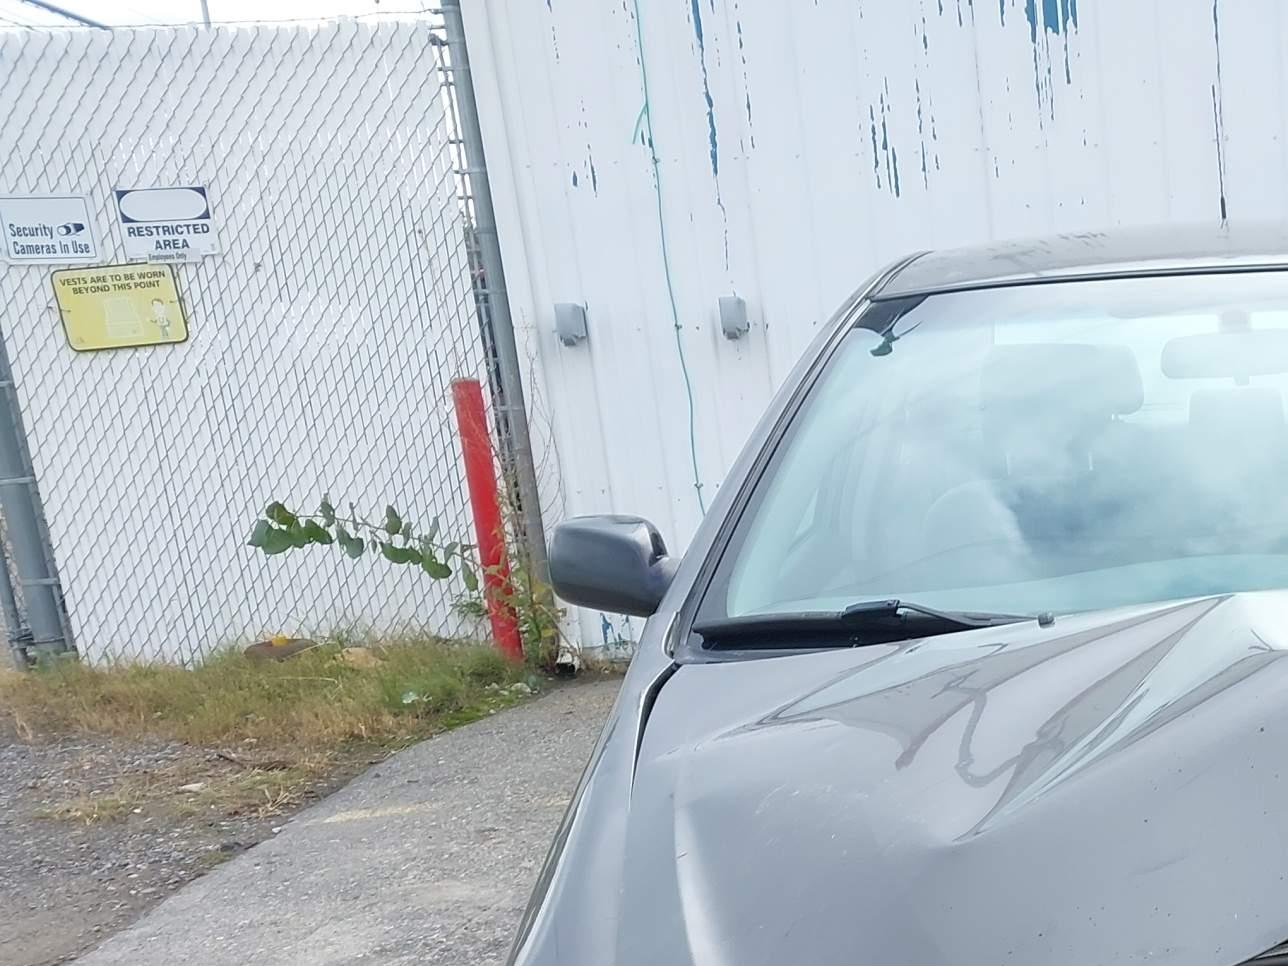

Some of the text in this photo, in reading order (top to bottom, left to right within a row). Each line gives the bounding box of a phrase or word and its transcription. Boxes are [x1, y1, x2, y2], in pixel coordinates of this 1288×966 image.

[9, 223, 53, 239] Security
[127, 223, 210, 237] RESTRICTED
[13, 240, 90, 255] Cameras In Use
[155, 239, 190, 250] AREA
[60, 270, 166, 286] VESTS ARE TO BE WORN
[72, 280, 160, 295] BEYOND THIS POINT
